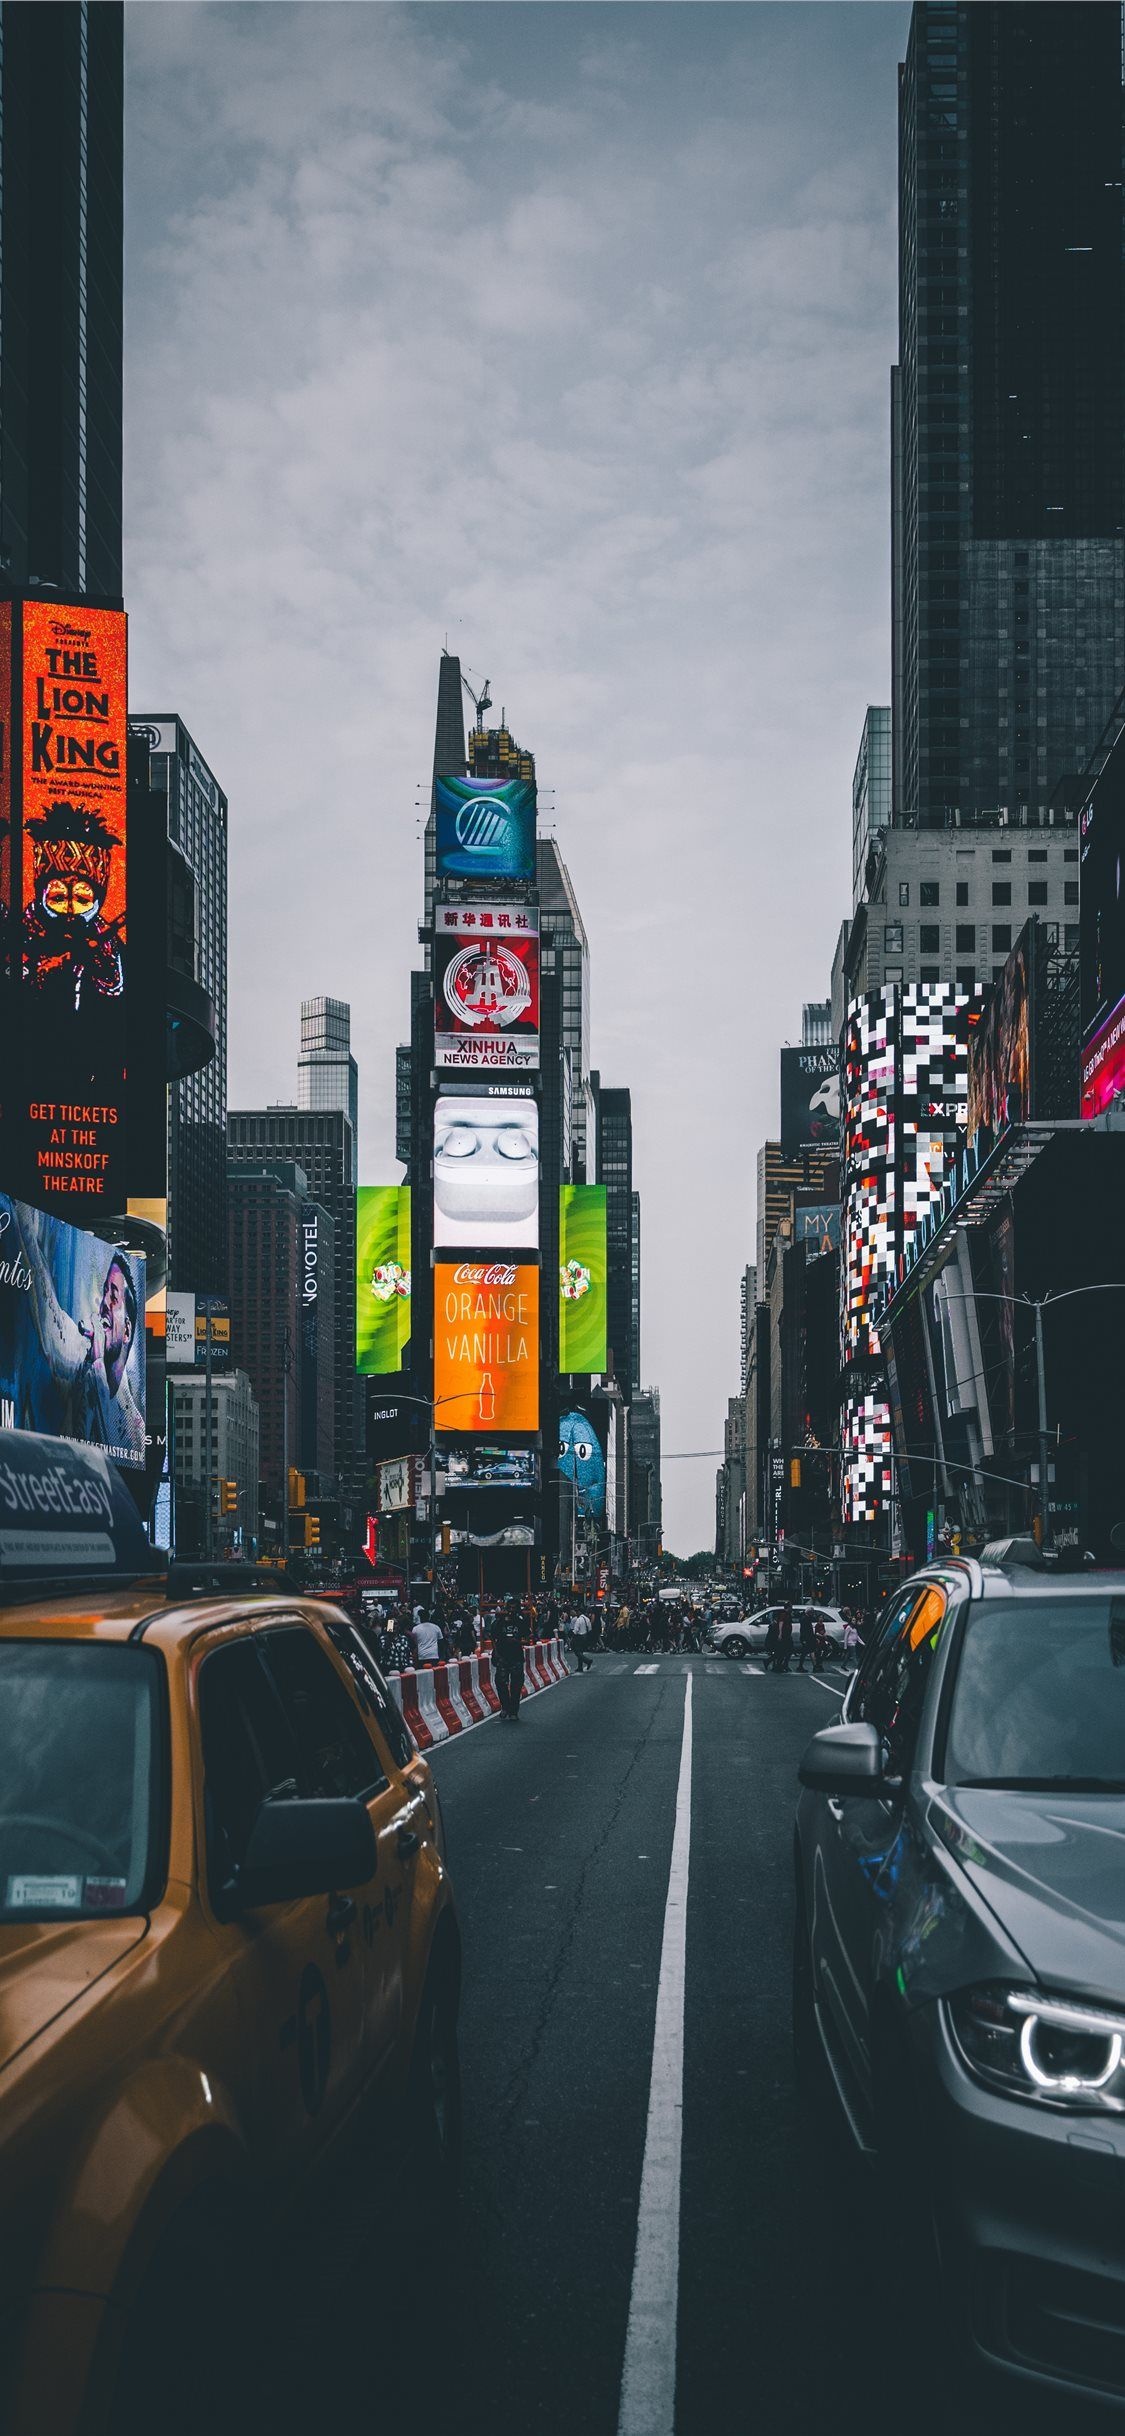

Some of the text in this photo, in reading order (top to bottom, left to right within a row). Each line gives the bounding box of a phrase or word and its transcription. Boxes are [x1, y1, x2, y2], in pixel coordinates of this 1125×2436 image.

[45, 648, 97, 676] THE
[37, 677, 108, 720] LION
[32, 722, 119, 773] KING
[444, 911, 529, 929] 新华通讯社
[457, 1040, 518, 1055] XINHUA
[444, 1054, 532, 1066] NEWS AGENCY
[804, 1066, 816, 1074] OF
[817, 1065, 834, 1073] THE
[488, 1086, 532, 1097] SAMSUNG
[30, 1103, 118, 1124] GET TICKETS
[50, 1128, 96, 1146] AT THE
[37, 1151, 109, 1170] MINSKOFF
[43, 1174, 104, 1193] THEATRE
[905, 1128, 979, 1275] BROADWAY
[804, 1212, 834, 1235] MY
[454, 1263, 520, 1285] Coca-Cola
[445, 1292, 529, 1325] ORANGE
[446, 1332, 529, 1364] VANILLA
[373, 1408, 398, 1421] INGLOT
[0, 1463, 114, 1528] StreetEasy
